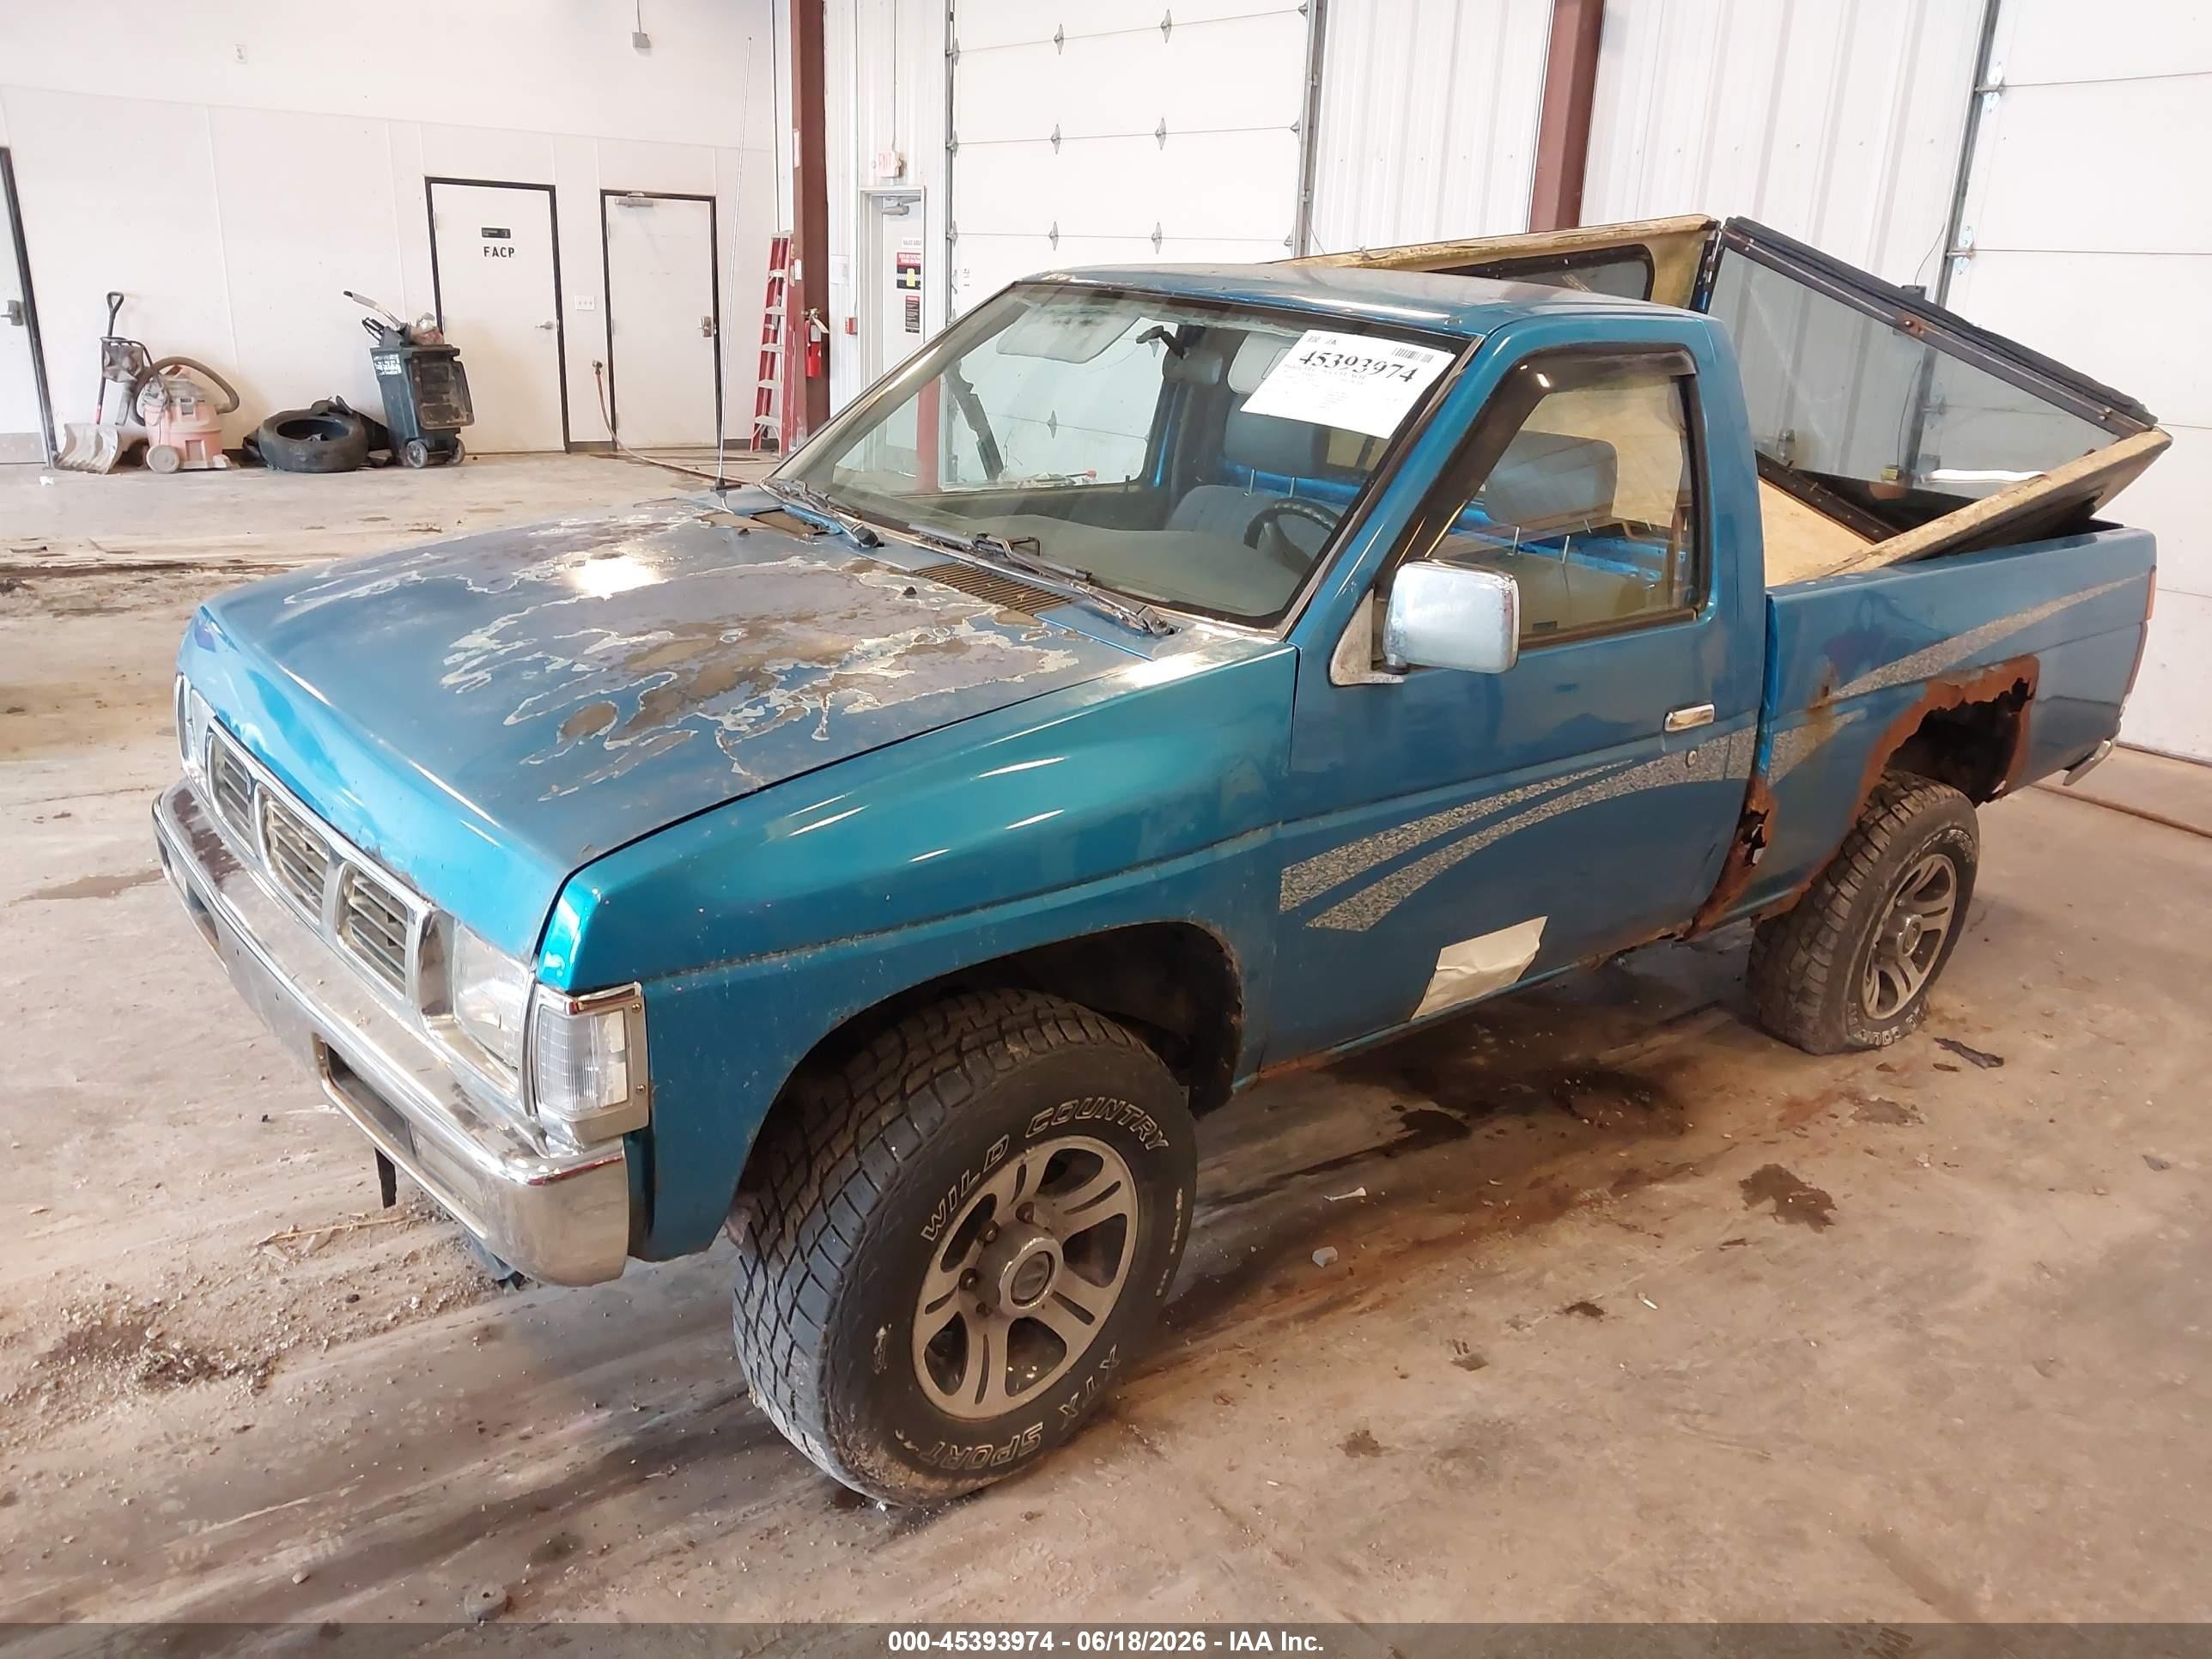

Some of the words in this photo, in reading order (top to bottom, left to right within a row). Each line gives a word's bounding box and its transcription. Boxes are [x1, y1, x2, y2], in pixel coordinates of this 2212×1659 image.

[483, 246, 515, 258] FACP
[1298, 349, 1419, 383] 45393974
[921, 1133, 1010, 1242] WILD
[1024, 1097, 1170, 1151] COUNTRY
[1058, 1343, 1120, 1431] XTX
[919, 1421, 1044, 1470] SPORT
